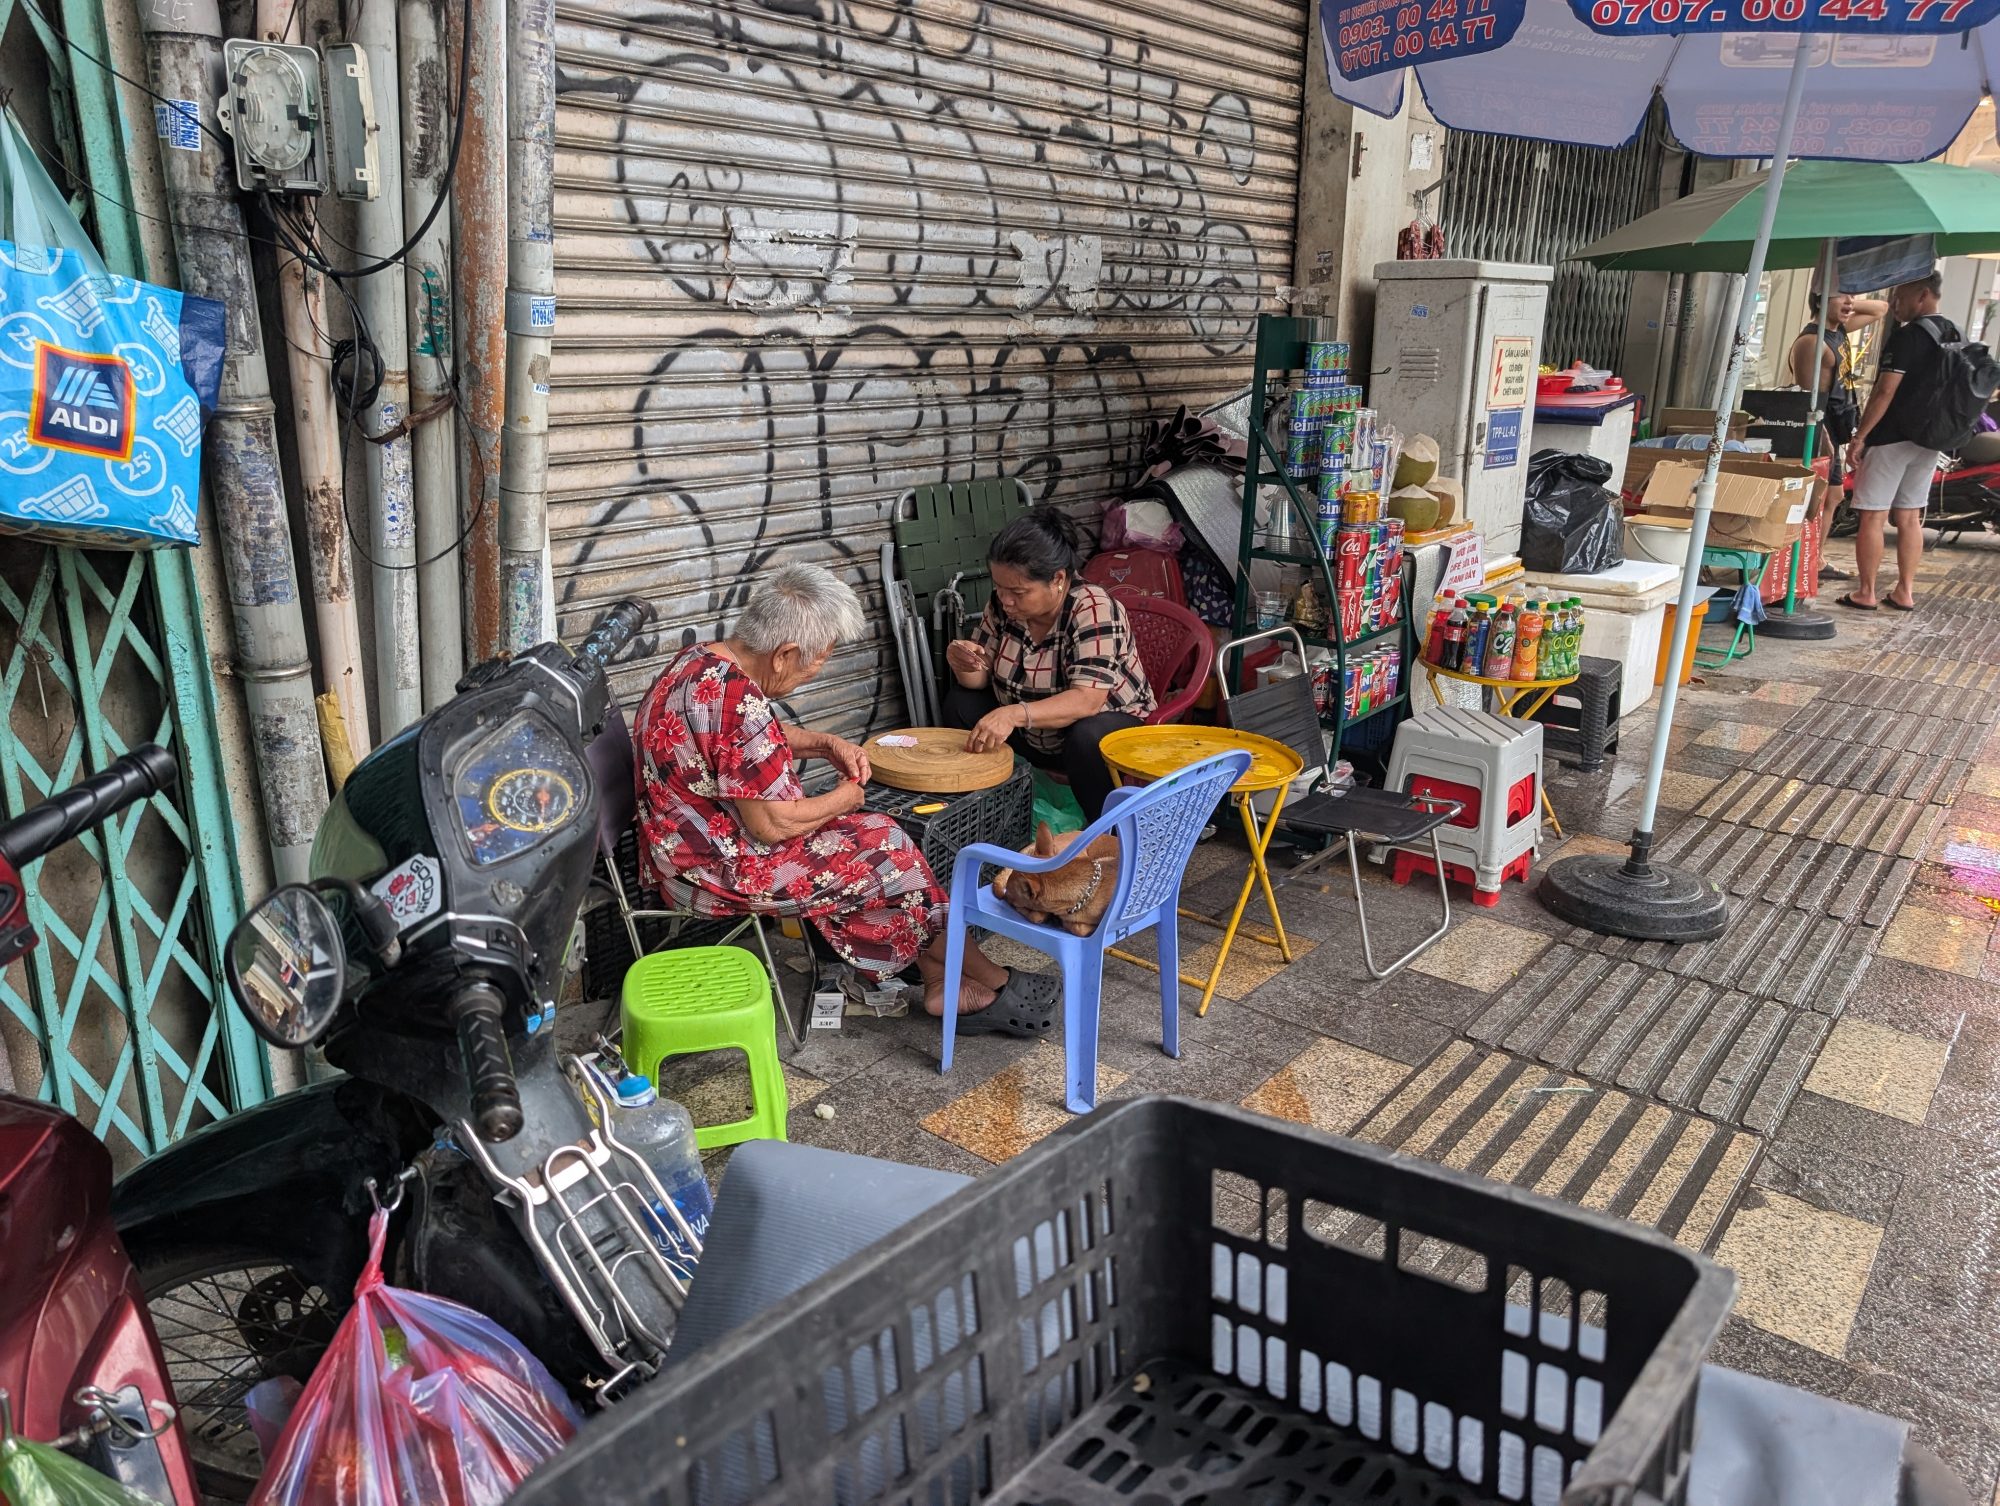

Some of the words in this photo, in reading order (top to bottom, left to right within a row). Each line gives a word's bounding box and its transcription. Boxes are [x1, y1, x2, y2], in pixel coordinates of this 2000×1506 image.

[1339, 16, 1391, 48] 0903.
[1396, 4, 1421, 31] 00
[1591, 0, 1726, 25] 0707.
[1340, 40, 1390, 72] 0707.
[1394, 31, 1424, 58] 00
[1429, 23, 1458, 50] 44
[1462, 14, 1496, 44] 77
[49, 407, 118, 438] ALDI
[1494, 633, 1514, 655] C2
